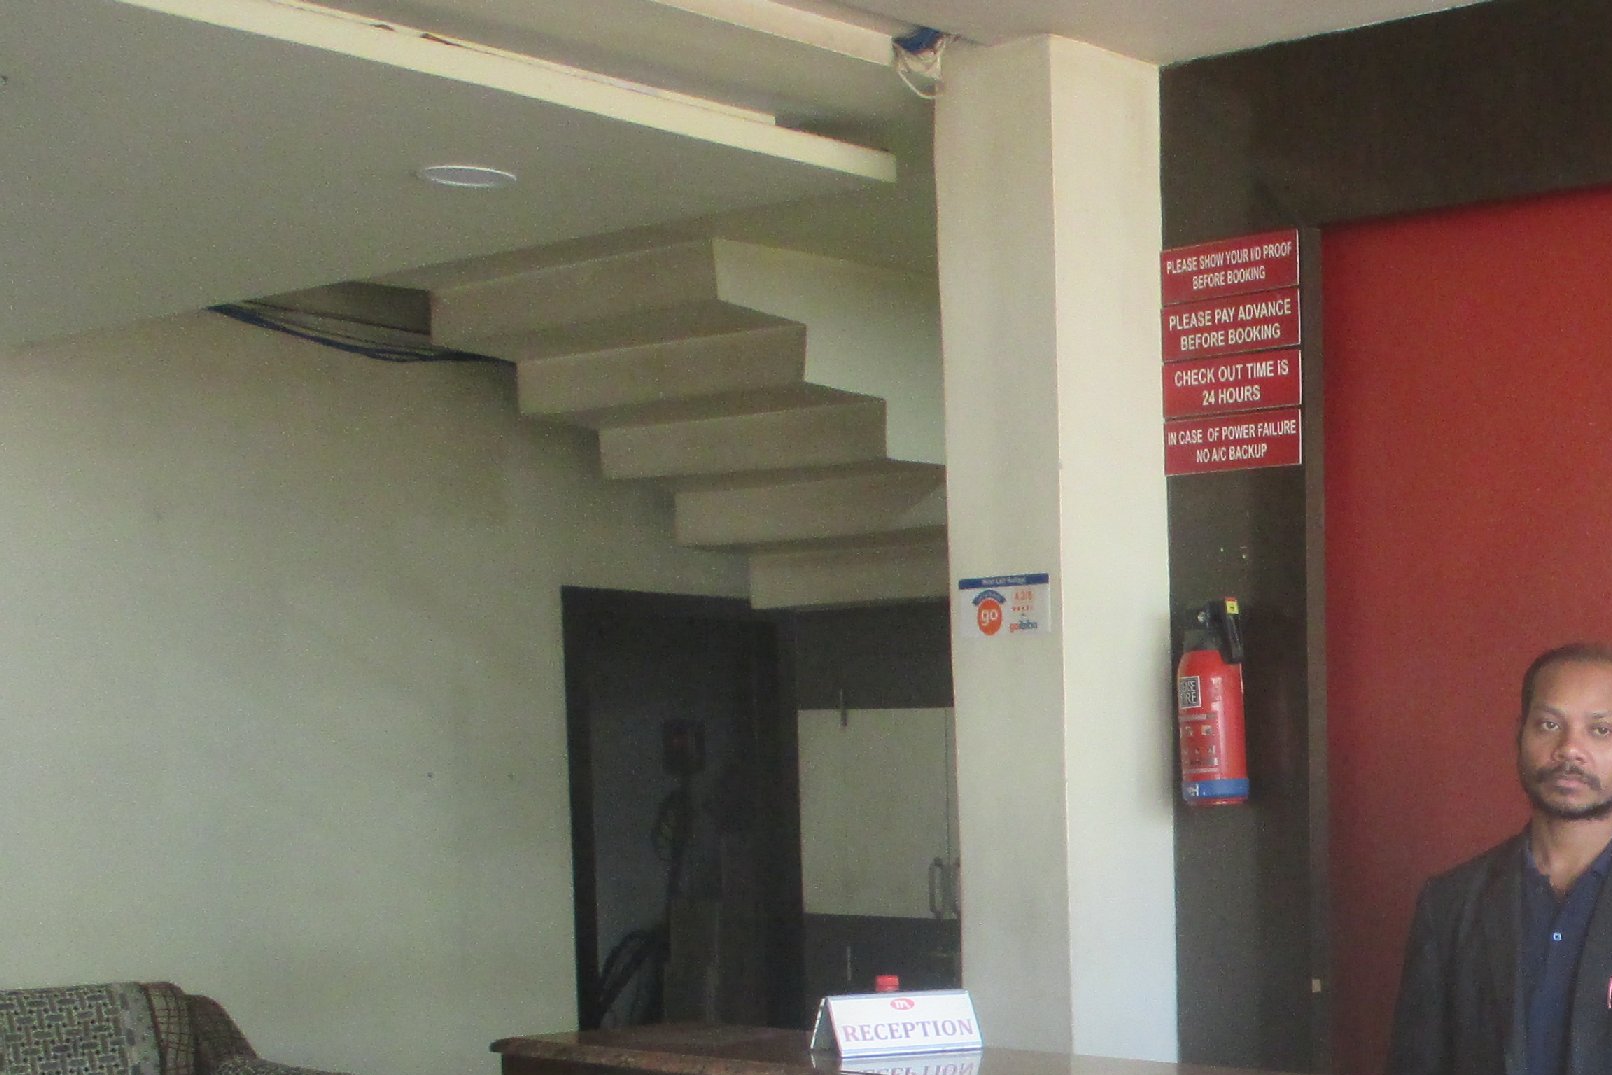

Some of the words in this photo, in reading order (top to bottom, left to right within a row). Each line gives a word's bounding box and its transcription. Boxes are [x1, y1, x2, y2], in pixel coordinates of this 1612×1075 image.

[1166, 256, 1198, 274] PLEASE
[1199, 252, 1225, 270] SHOW
[1225, 248, 1249, 265] YOUR
[1263, 241, 1293, 260] PROOF
[1192, 271, 1226, 290] BEFORE
[1227, 265, 1266, 284] BOOKING
[1169, 310, 1212, 331] PLEASE
[1214, 307, 1235, 325] PAY
[1237, 298, 1292, 321] ADVANCE
[1180, 330, 1226, 351] BEFORE
[1228, 323, 1281, 344] BOOKING
[1174, 367, 1216, 387] CHECK
[1218, 363, 1244, 381] OUT
[1245, 361, 1275, 378] TIME
[1202, 389, 1216, 406] 24
[1218, 384, 1261, 404] HOURS
[1167, 431, 1177, 446] IN
[1178, 429, 1203, 445] CASE
[1207, 428, 1220, 442] OF
[1221, 424, 1256, 440] POWER
[1257, 420, 1297, 437] FAILURE
[1196, 448, 1210, 463] NO
[1228, 443, 1268, 461] BACKUP
[841, 1018, 974, 1042] RECEPTION
